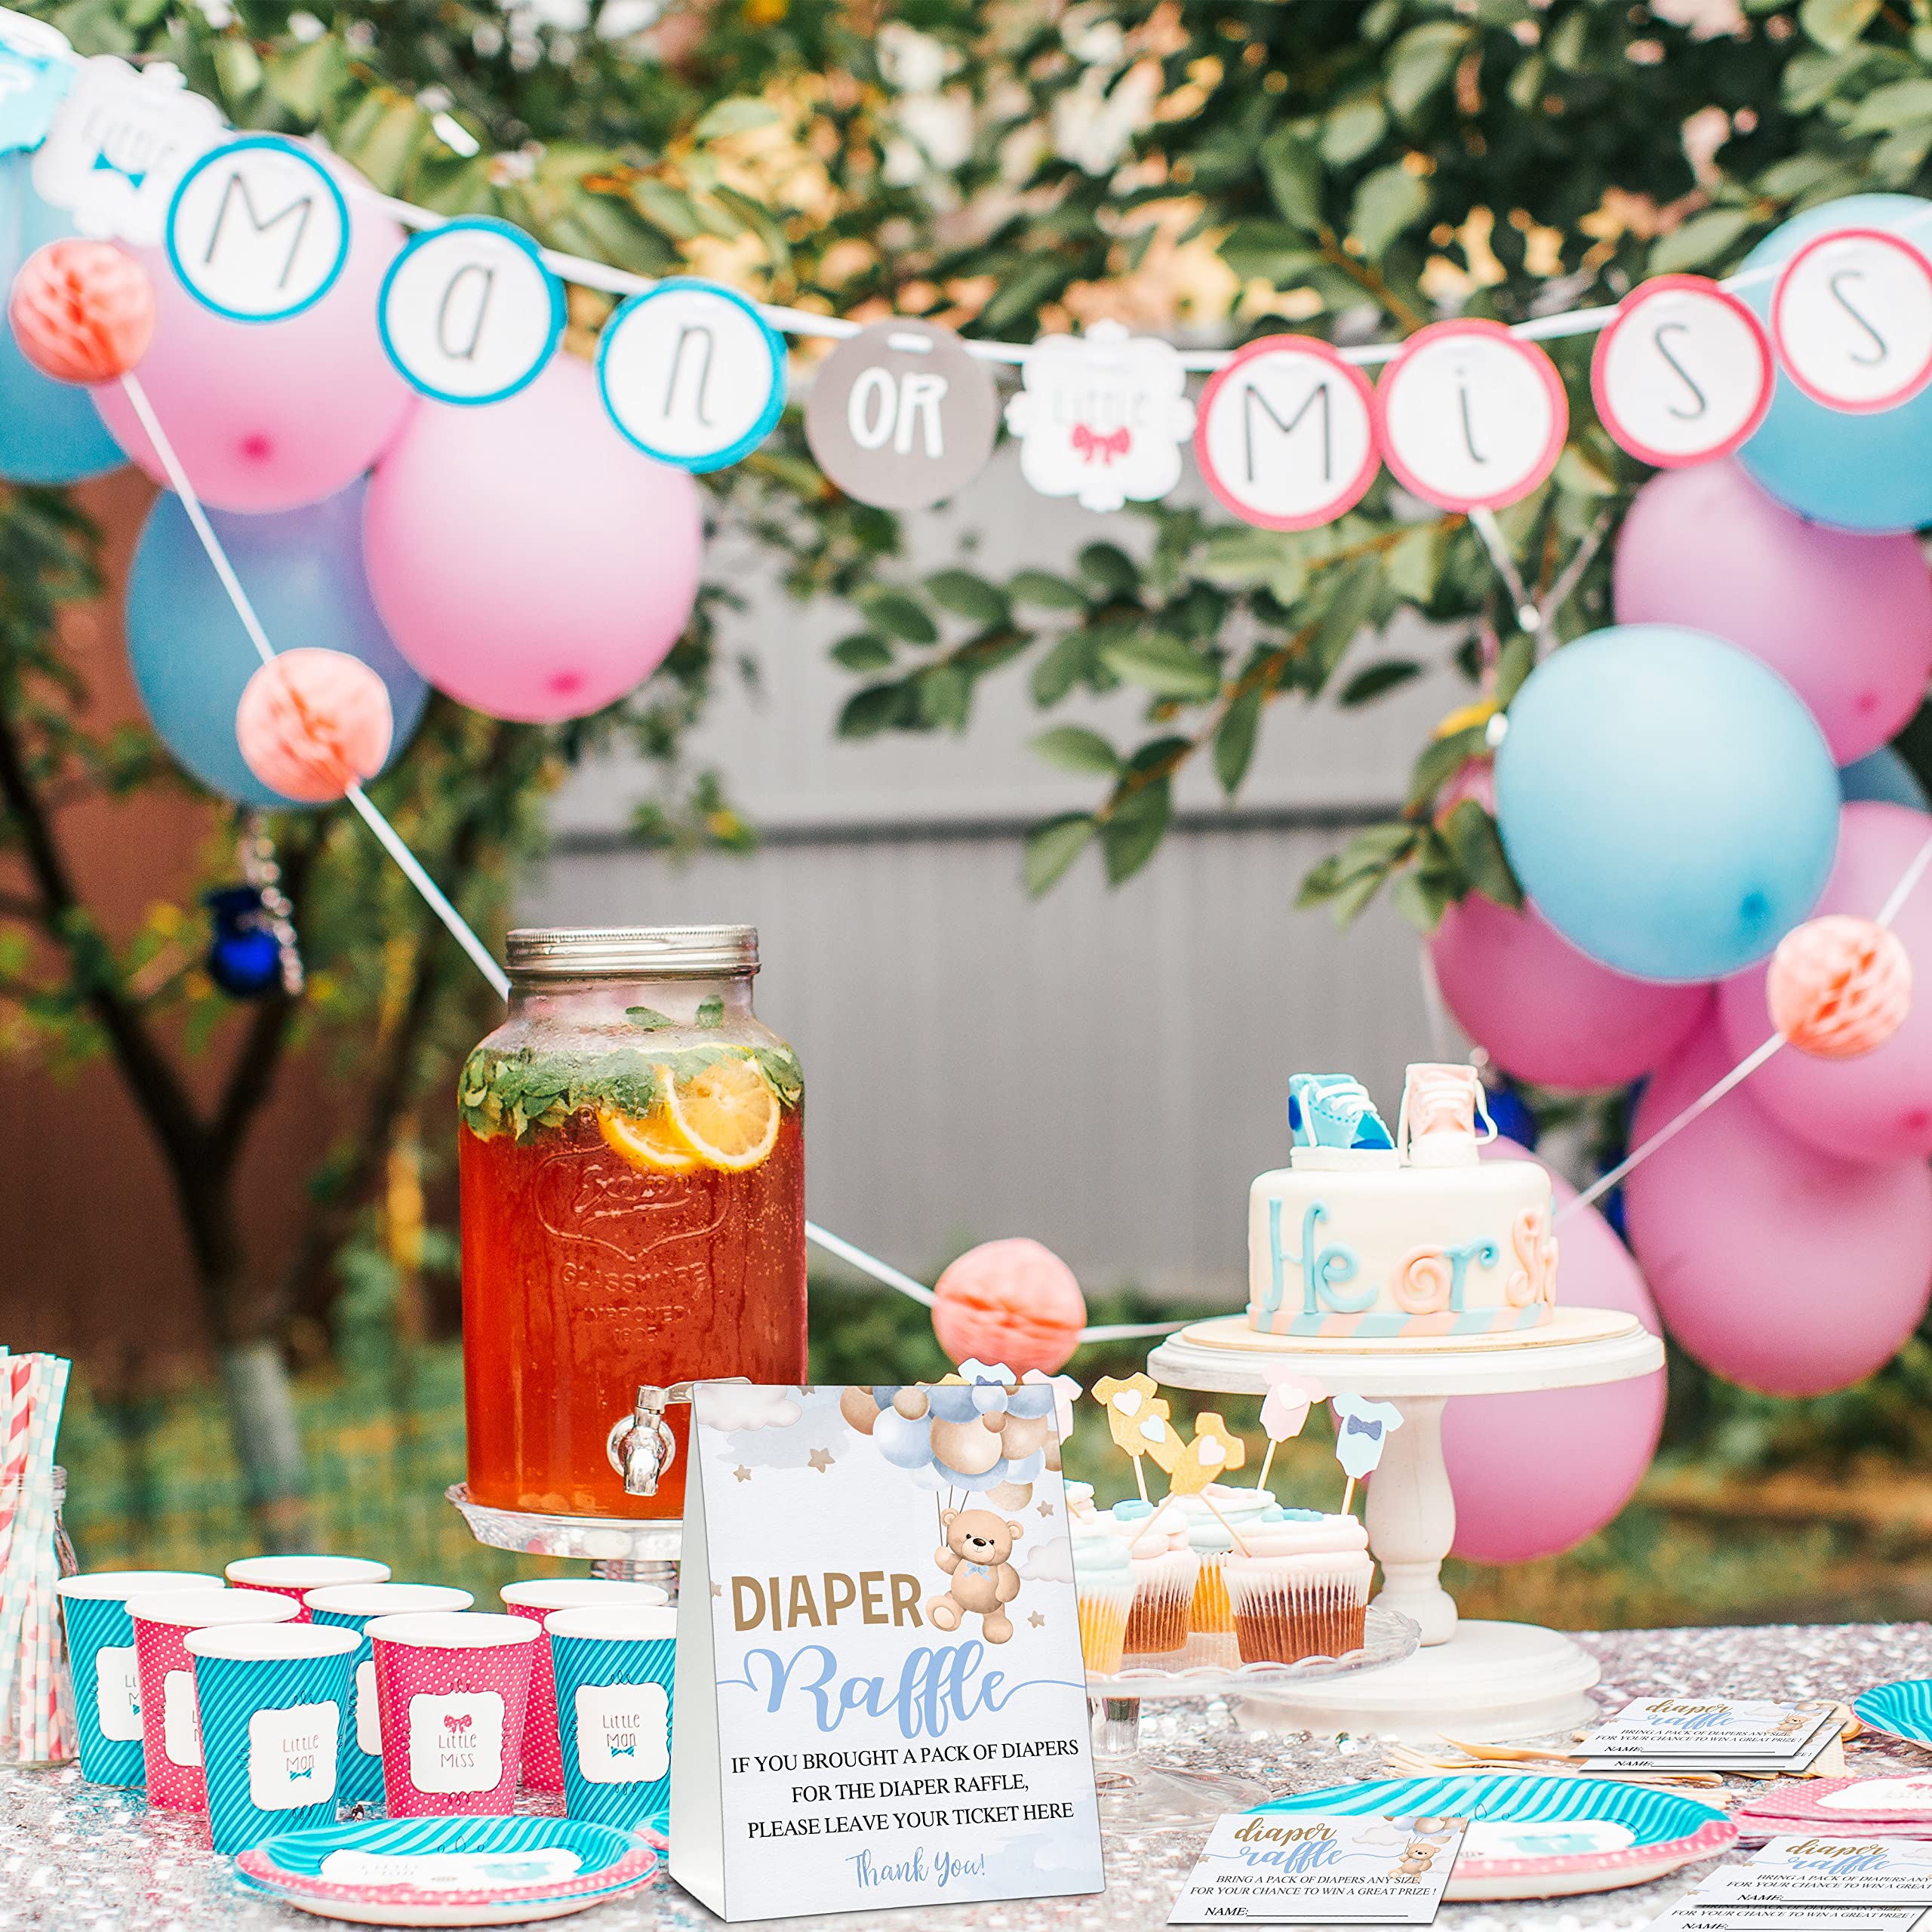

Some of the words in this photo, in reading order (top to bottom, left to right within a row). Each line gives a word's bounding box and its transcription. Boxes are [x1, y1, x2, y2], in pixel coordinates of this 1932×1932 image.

[847, 366, 949, 459] OR
[1263, 1198, 1379, 1314] He
[1390, 1236, 1500, 1315] or
[731, 1571, 924, 1632] DIAPER
[736, 1639, 1030, 1740] Raffle
[1645, 1700, 1733, 1715] diaper
[1647, 1712, 1735, 1730] raffle
[731, 1757, 749, 1774] IF
[755, 1755, 798, 1772] YOU
[802, 1749, 899, 1770] BROUGHT
[902, 1749, 917, 1764] A
[920, 1745, 969, 1764] PACK
[973, 1743, 998, 1759] OF
[1001, 1739, 1078, 1758] DIAPERS
[791, 1786, 832, 1803] FOR
[835, 1784, 875, 1800] THE
[879, 1779, 950, 1798] DIAPER
[954, 1774, 1029, 1793] RAFFLE,
[748, 1819, 821, 1838] PLEASE
[824, 1814, 889, 1834] LEAVE
[892, 1810, 949, 1829] YOUR
[952, 1806, 1019, 1826] TICKET
[1023, 1802, 1075, 1820] HERE
[1234, 1817, 1339, 1847] diaper
[1239, 1839, 1344, 1874] raffle
[1786, 1839, 1890, 1858] diaper
[1787, 1854, 1891, 1875] raffle
[845, 1846, 929, 1887] Thank
[934, 1851, 985, 1887] You!
[1204, 1907, 1248, 1915] NAME:
